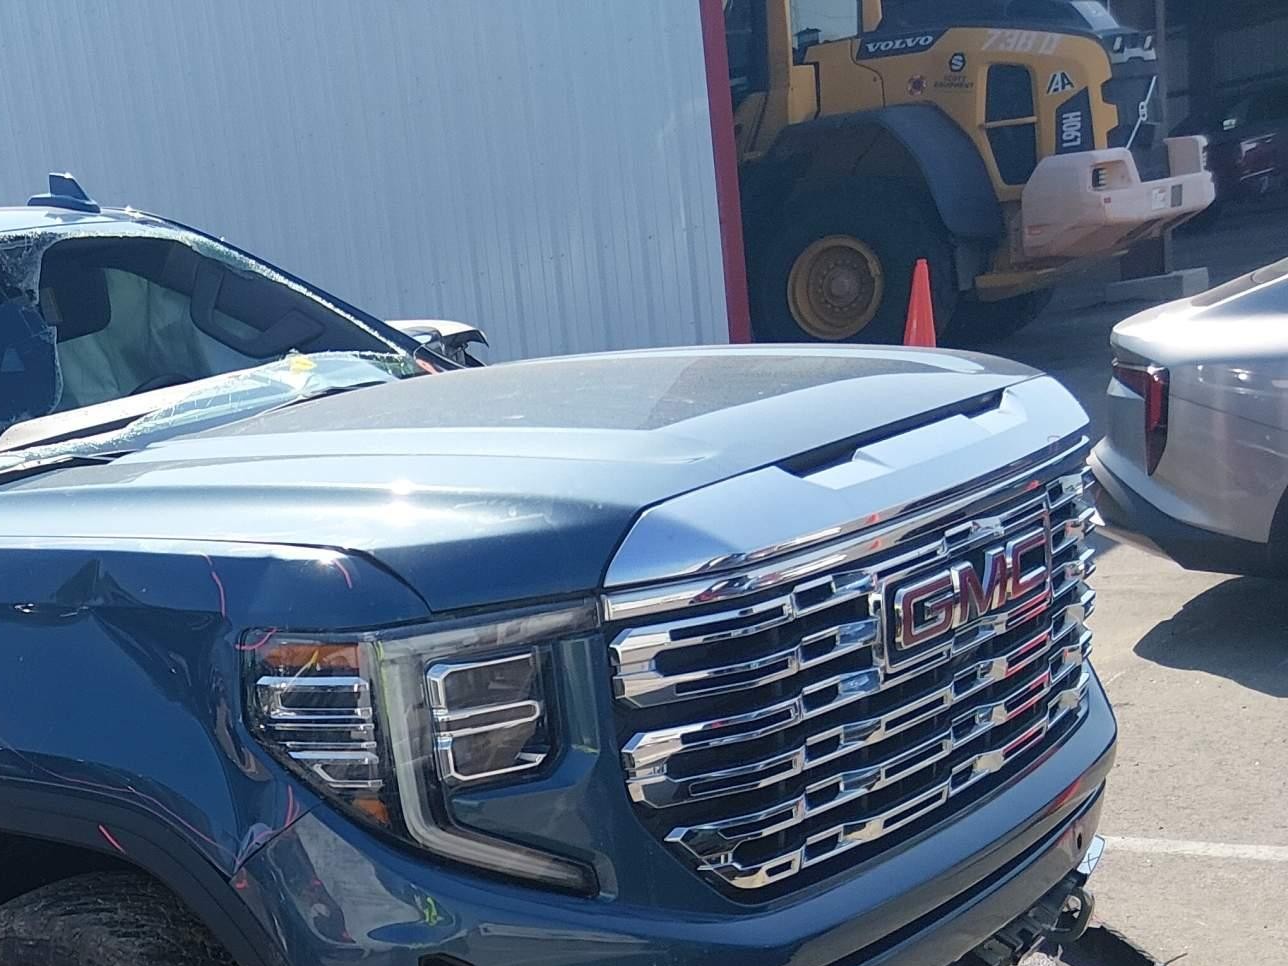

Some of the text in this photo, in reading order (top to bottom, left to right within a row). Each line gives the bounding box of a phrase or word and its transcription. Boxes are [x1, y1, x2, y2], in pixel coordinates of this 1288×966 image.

[865, 35, 934, 53] VOLVO
[1062, 111, 1081, 148] L90H
[895, 528, 1048, 650] GMC
